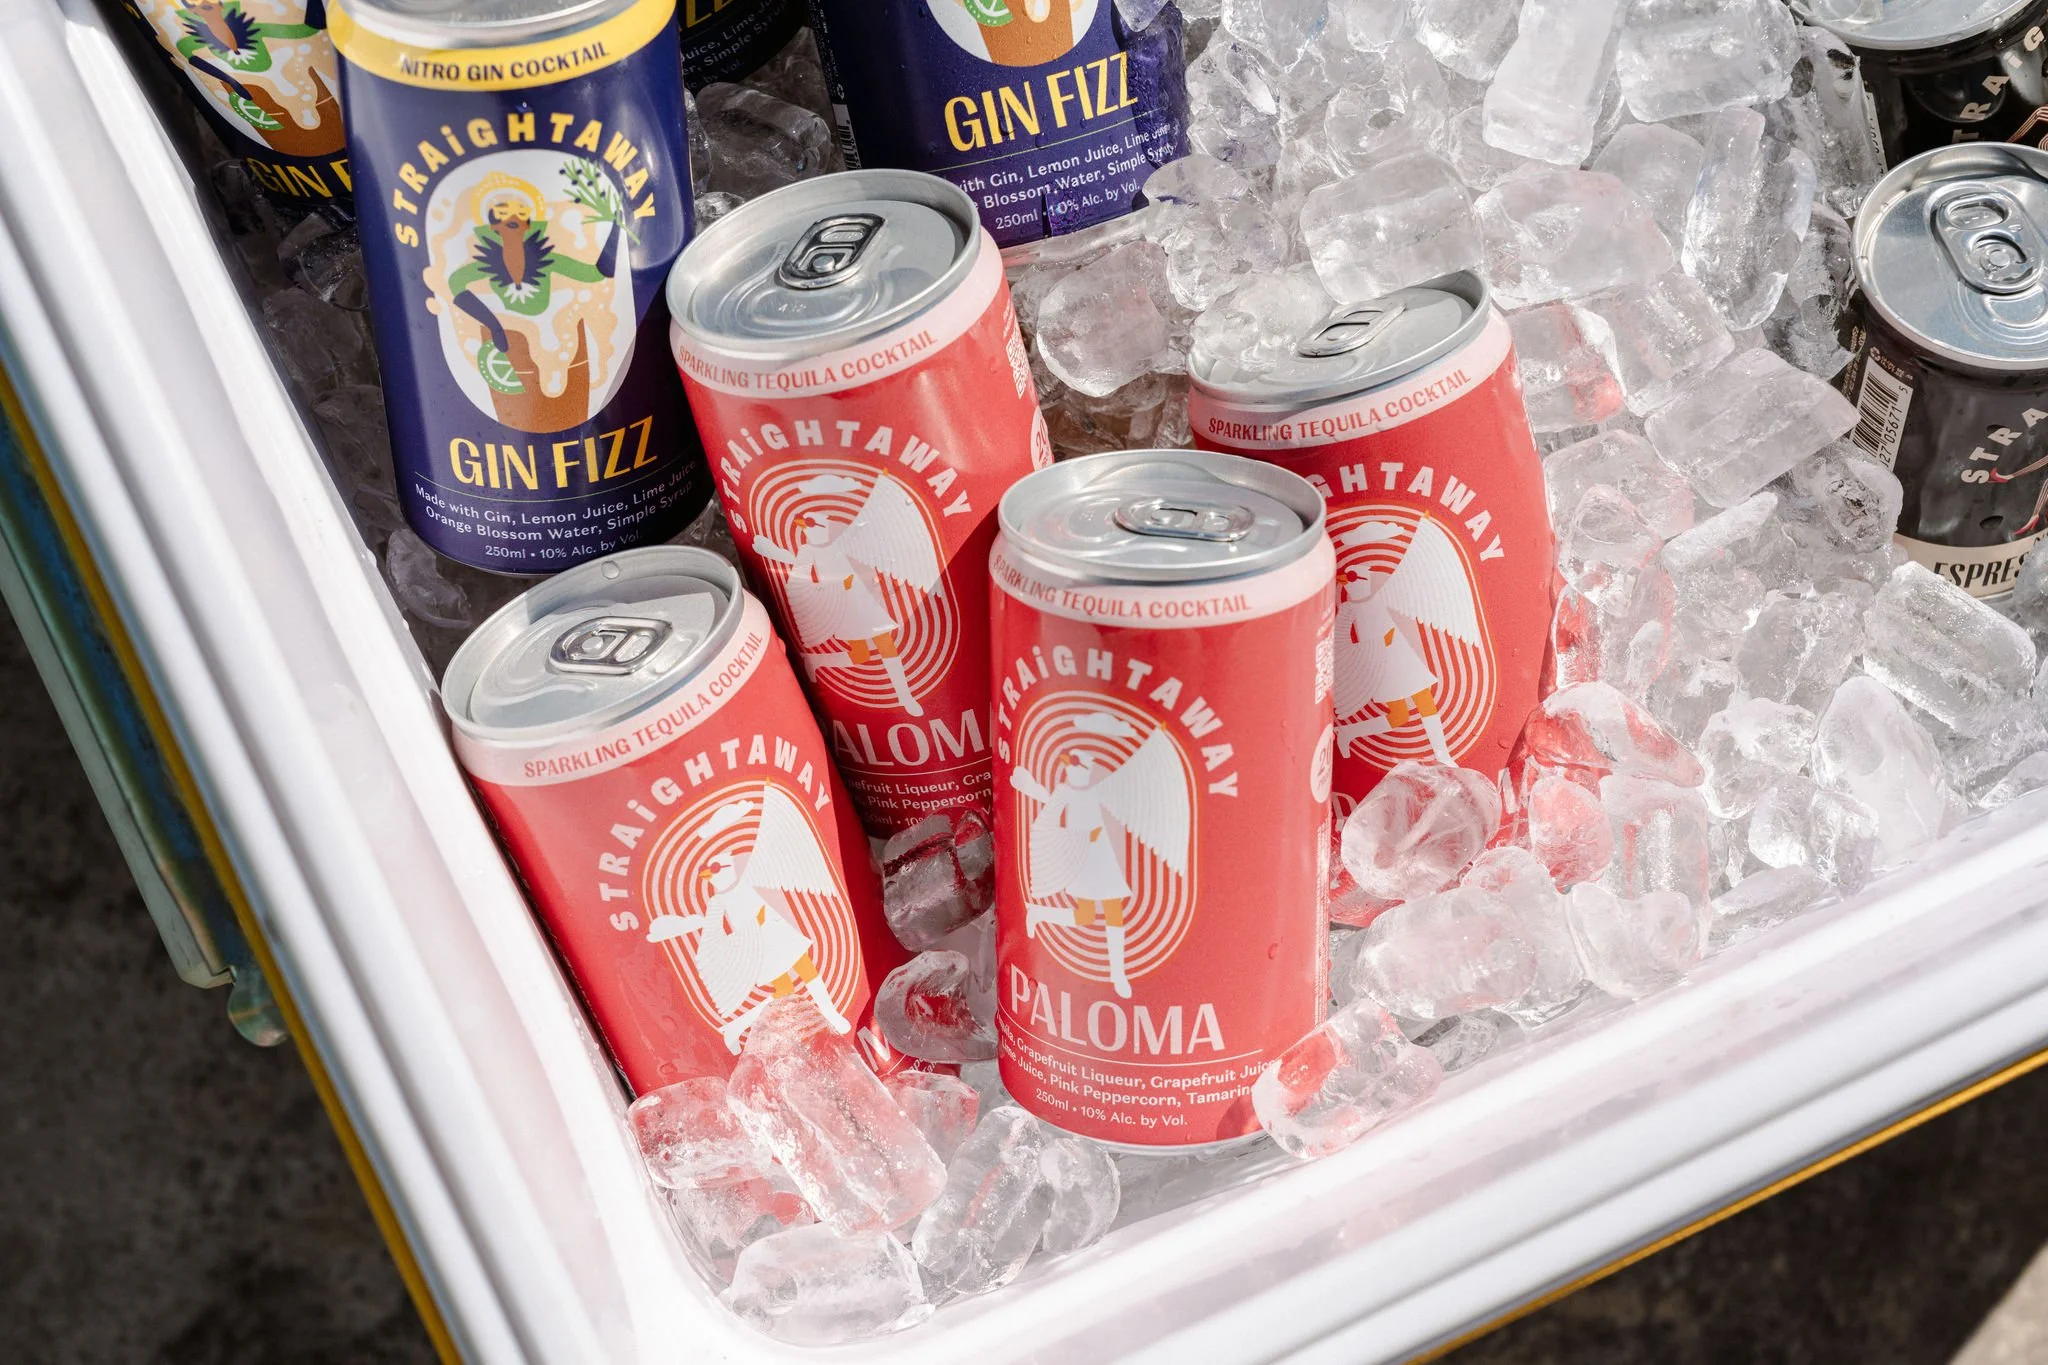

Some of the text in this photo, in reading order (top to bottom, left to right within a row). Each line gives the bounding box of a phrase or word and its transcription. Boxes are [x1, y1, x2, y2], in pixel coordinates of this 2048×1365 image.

[401, 41, 610, 81] NITRO GIN COCKTAIL
[704, 33, 751, 67] Simple
[944, 81, 1041, 153] GIN
[1047, 51, 1138, 129] FIZZ
[246, 157, 333, 197] GIN
[959, 177, 985, 193] ith
[990, 171, 1024, 185] Gin,
[1028, 154, 1080, 178] Lemon
[1085, 141, 1123, 163] Juice,
[1124, 131, 1150, 149] Lime
[1055, 171, 1105, 191] Water,
[1107, 154, 1146, 176] Simple
[995, 179, 1141, 230] 250ml 10% Alc. by Vol.
[679, 329, 938, 392] SPARKLING TEQUILA COCKTAIL
[1208, 369, 1471, 441] SPARKLING TEQUILA COCKTAIL
[450, 415, 658, 490] GIN FIZZ
[415, 484, 446, 508] Made
[449, 503, 479, 520] with
[485, 510, 516, 526] Gin,
[522, 511, 577, 525] Lemon
[582, 501, 629, 520] Juice,
[633, 484, 665, 504] Lime
[426, 480, 693, 541] Orange Blossom Water, Simple Syrup
[1304, 461, 1505, 562] GHTAWAY
[485, 531, 643, 560] 250ml 10% Alc. by Vol.
[992, 553, 1252, 619] SPARKLING TEQUILA COCKTAIL
[523, 631, 764, 779] SPARKLING TEQUILA COCKTAIL
[832, 702, 992, 767] ALOM
[868, 796, 898, 809] Pink
[896, 780, 959, 796] Liqueur,
[1011, 964, 1225, 1055] PALOMA
[1017, 1037, 1077, 1076] Grapefruit
[1082, 1068, 1146, 1090] Liqueur,
[1150, 1070, 1236, 1093] Grapefruit
[1017, 1056, 1047, 1084] Juice,
[1050, 1074, 1079, 1094] Pink
[1083, 1085, 1181, 1107] Peppercorn,
[1187, 1085, 1251, 1105] Tamarin
[1035, 1088, 1188, 1128] 250ml 10% Alc. by Vol.
